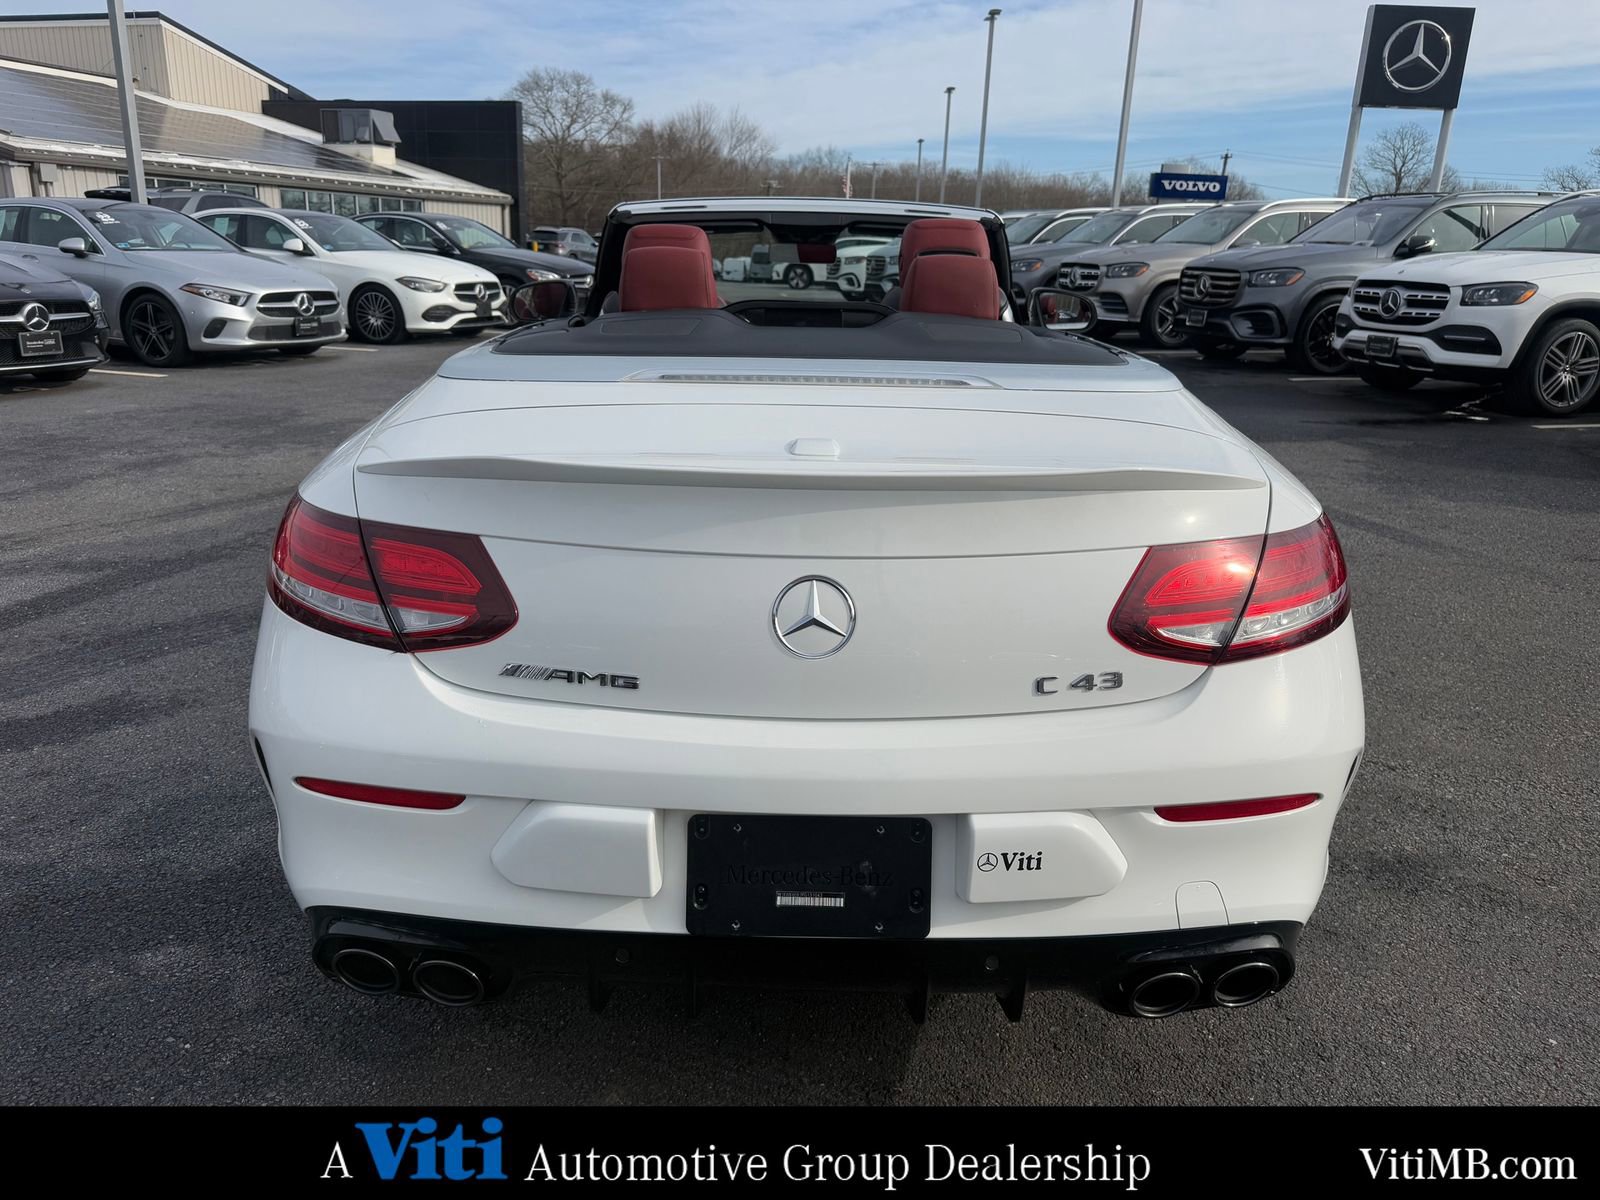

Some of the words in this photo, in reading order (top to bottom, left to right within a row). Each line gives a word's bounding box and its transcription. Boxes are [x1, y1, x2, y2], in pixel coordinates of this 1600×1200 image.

[1161, 180, 1221, 192] VOLVO
[545, 667, 640, 690] AMG
[1034, 675, 1059, 695] C
[1070, 671, 1124, 692] 43
[1000, 851, 1043, 872] Viti
[726, 863, 894, 887] Mercedes-Benz
